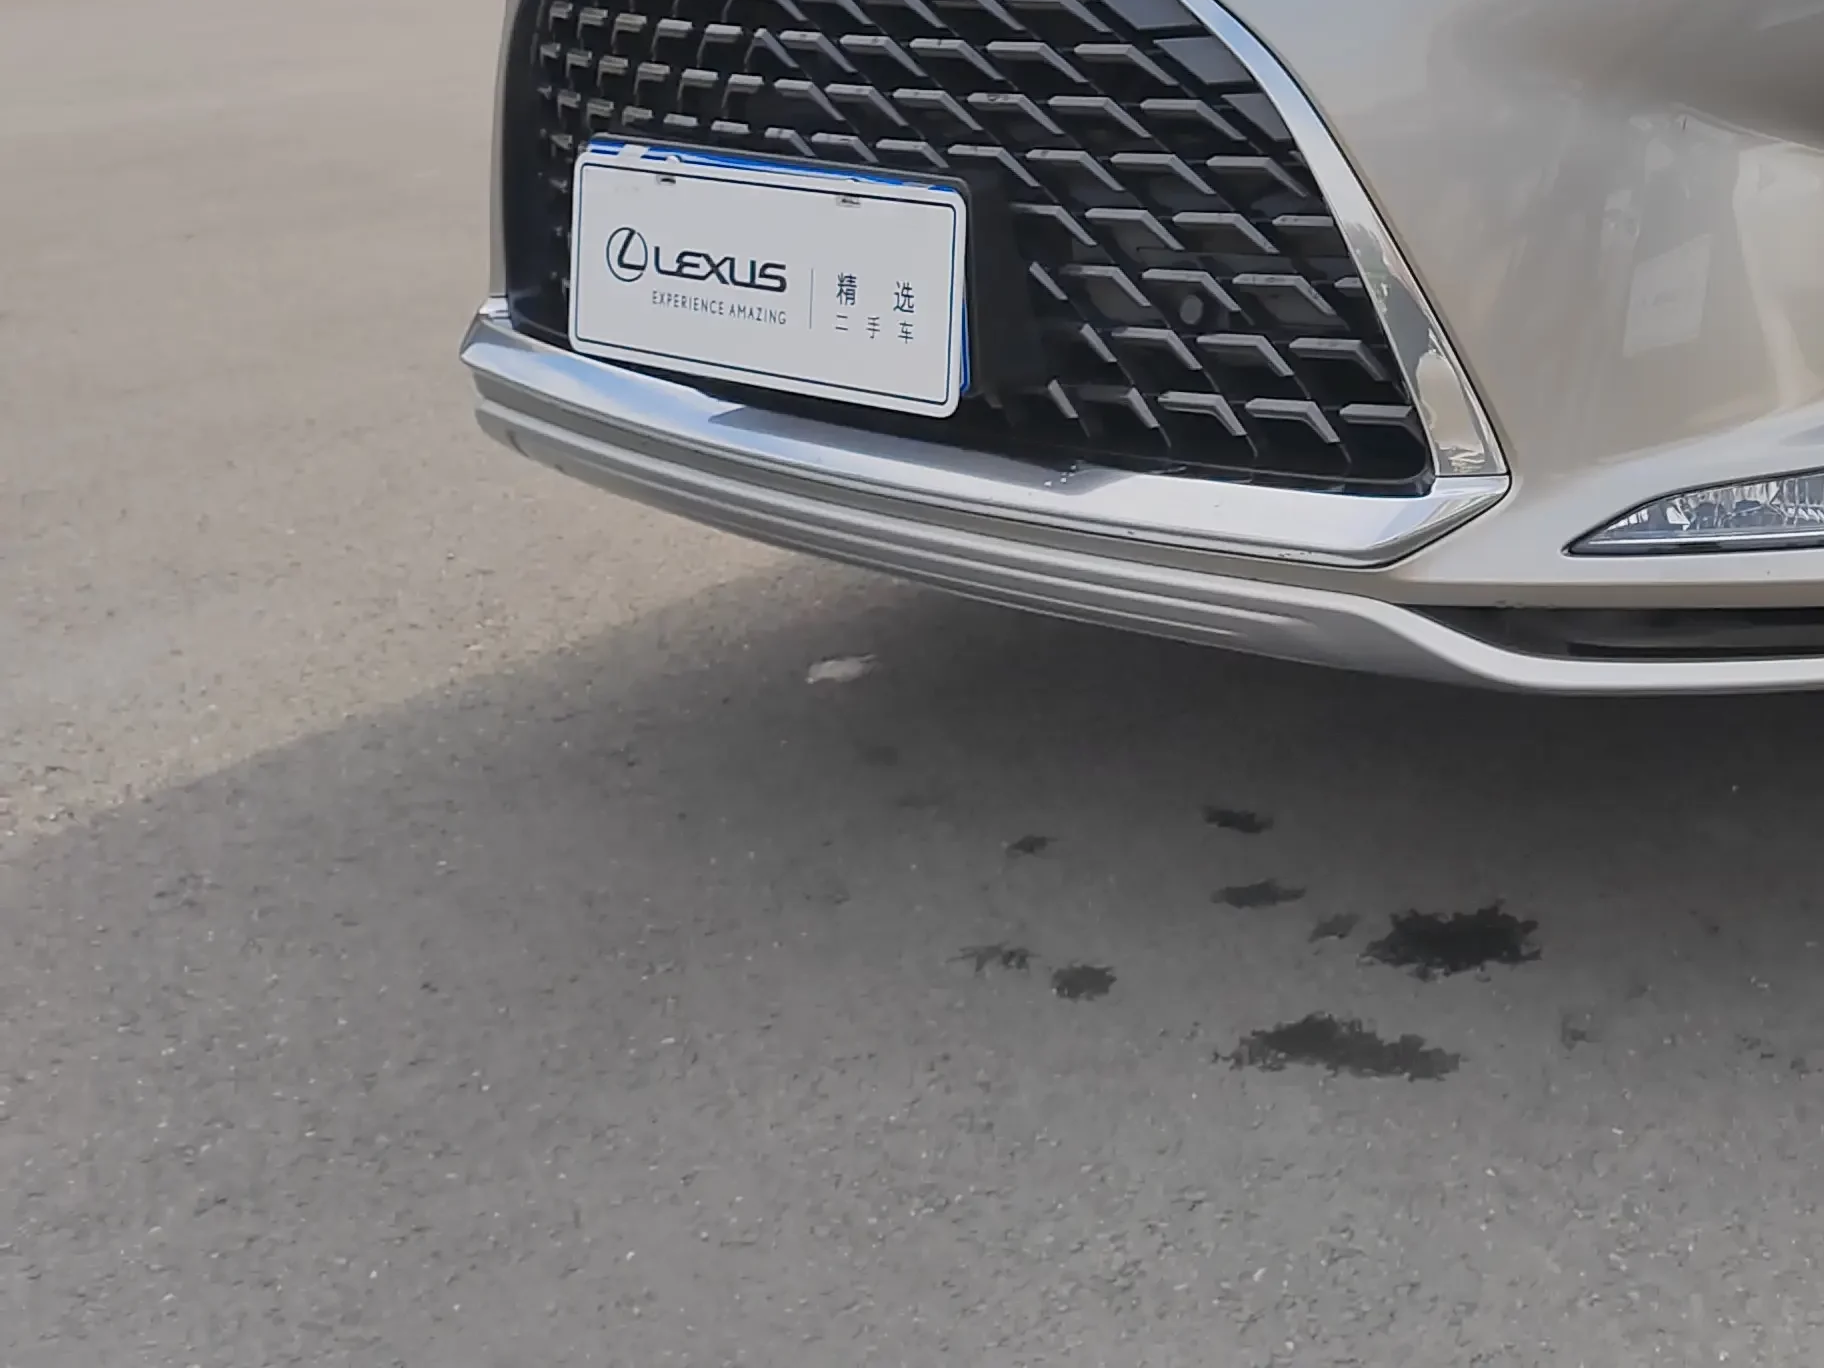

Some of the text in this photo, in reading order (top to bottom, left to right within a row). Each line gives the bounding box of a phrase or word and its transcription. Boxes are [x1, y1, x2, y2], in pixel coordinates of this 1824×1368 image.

[653, 245, 787, 292] LEXUS
[652, 289, 787, 325] EXPERIENCE AMAZING
[835, 272, 915, 314] 精选
[835, 314, 914, 344] 二手车
